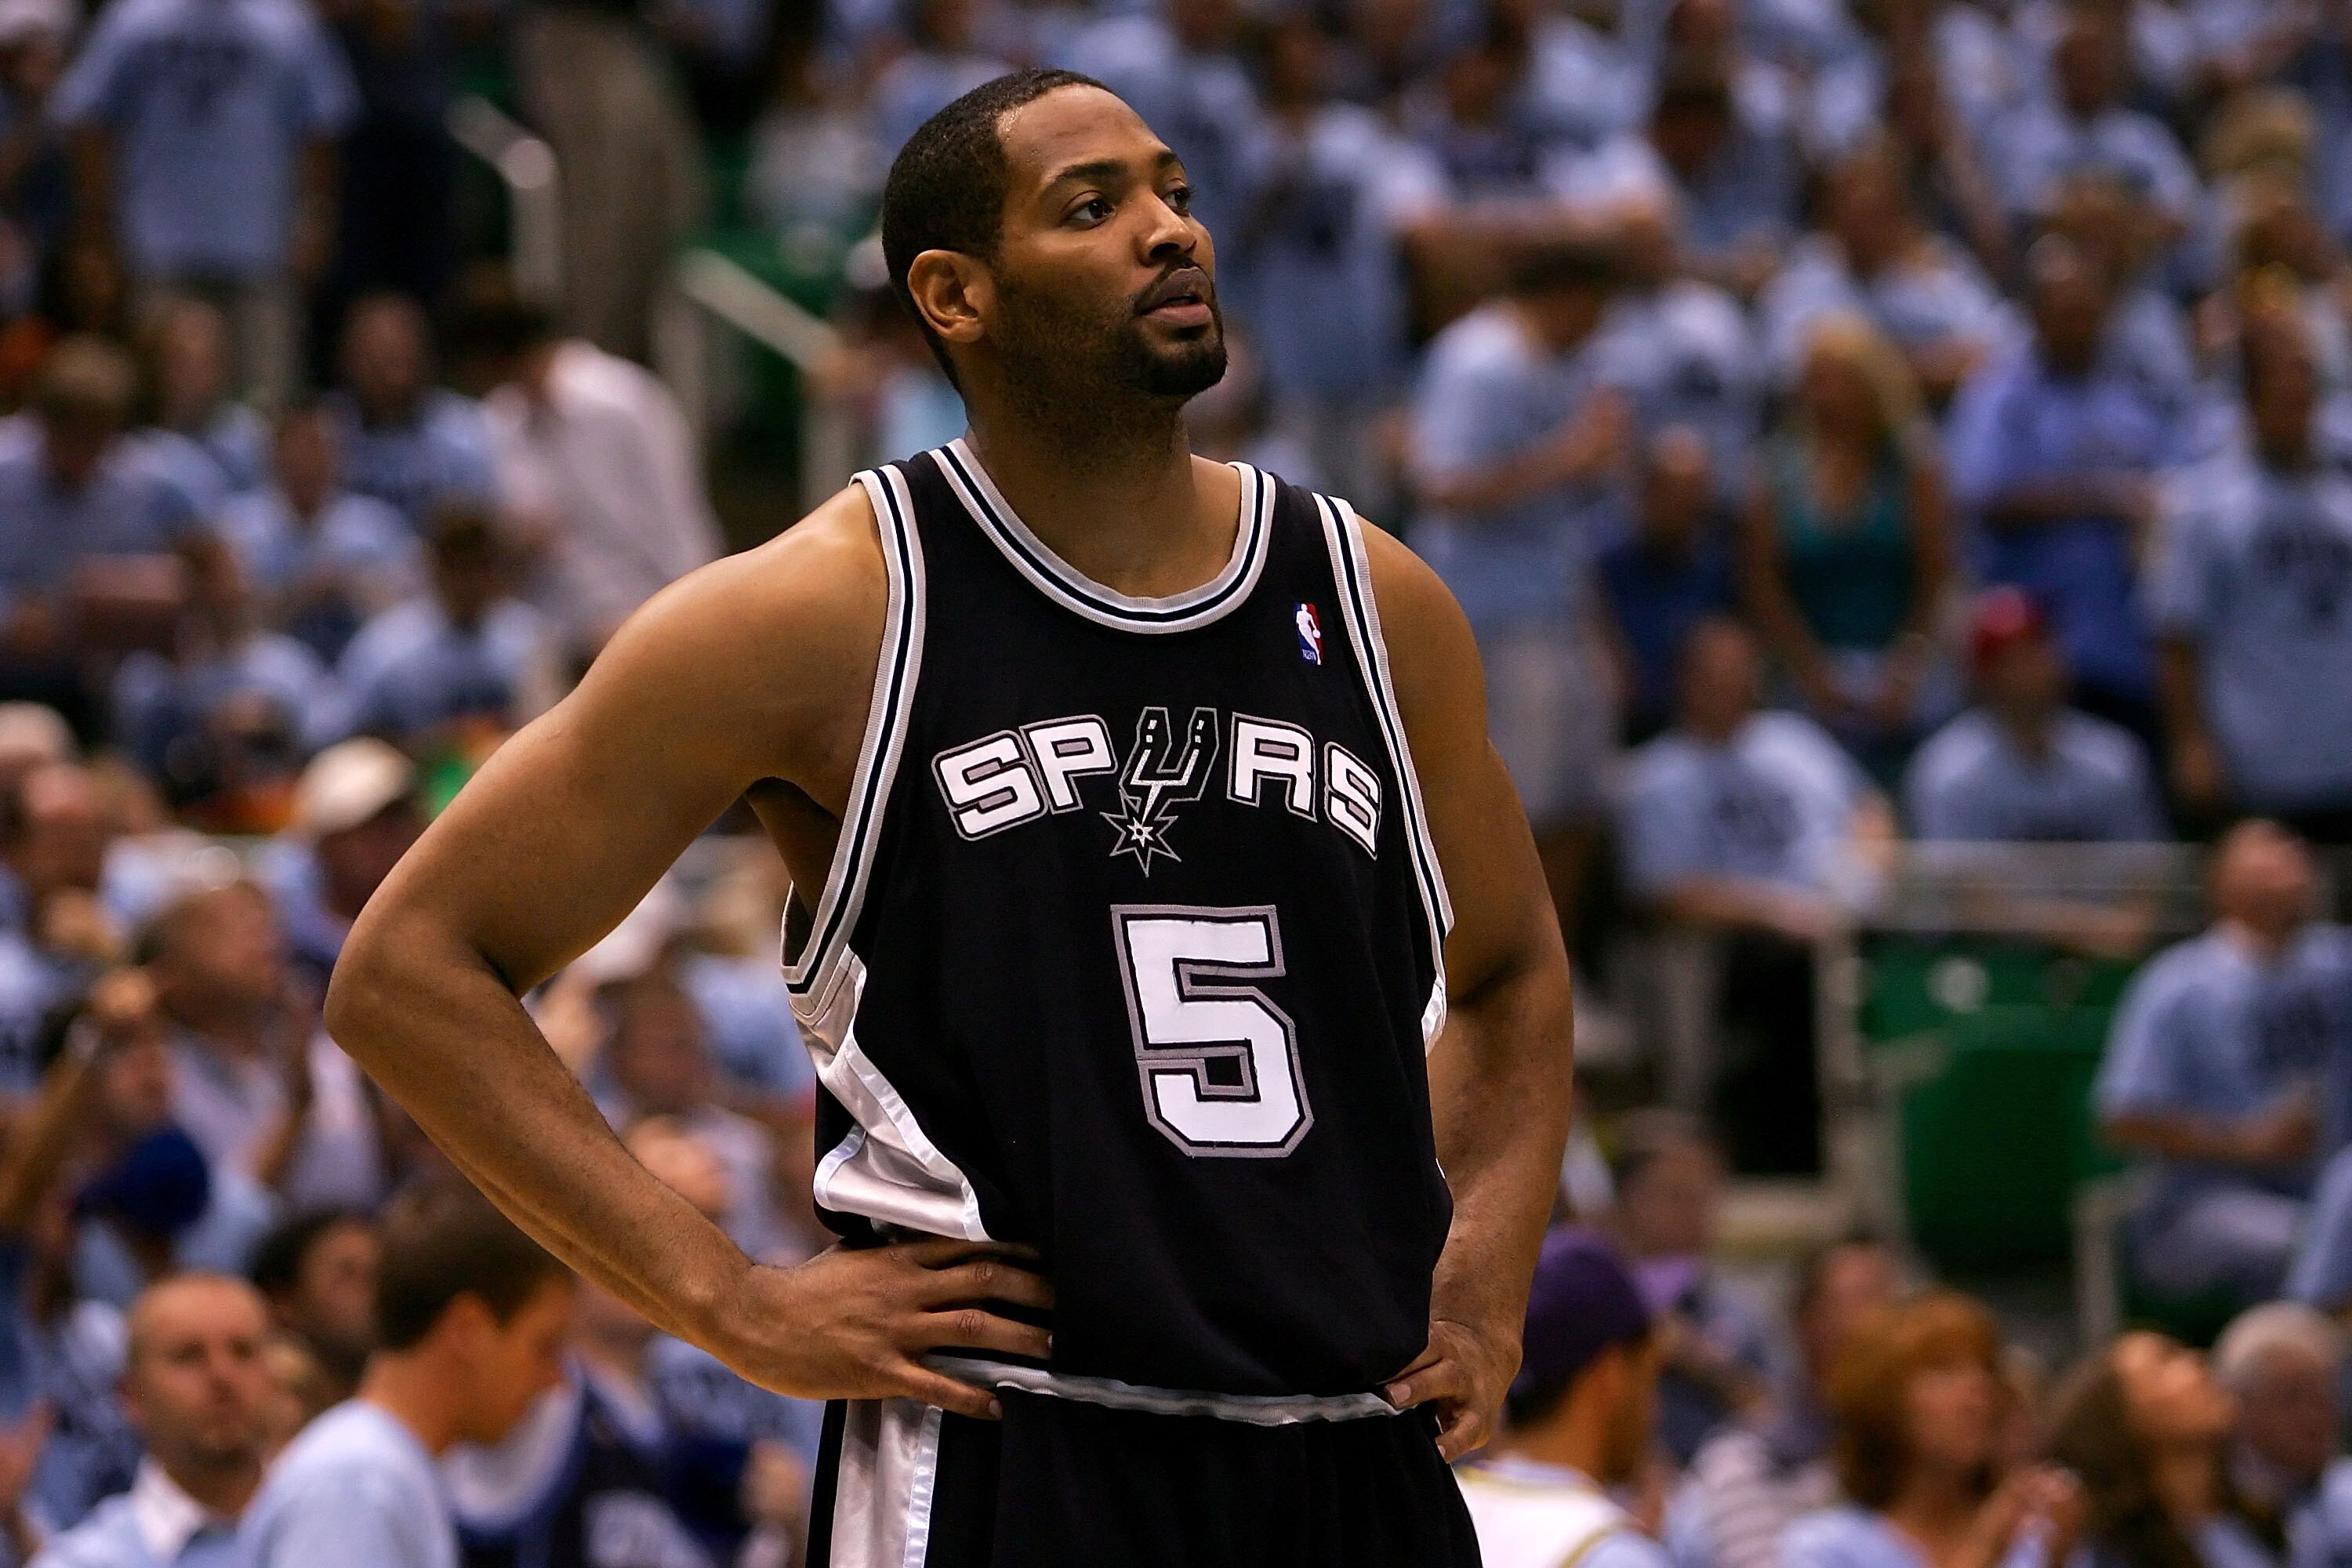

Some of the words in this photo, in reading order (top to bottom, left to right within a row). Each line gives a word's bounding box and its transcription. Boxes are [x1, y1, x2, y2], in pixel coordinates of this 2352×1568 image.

[1301, 648, 1316, 661] NBA
[931, 707, 1382, 877] SPURS
[1110, 904, 1314, 1157] 5
